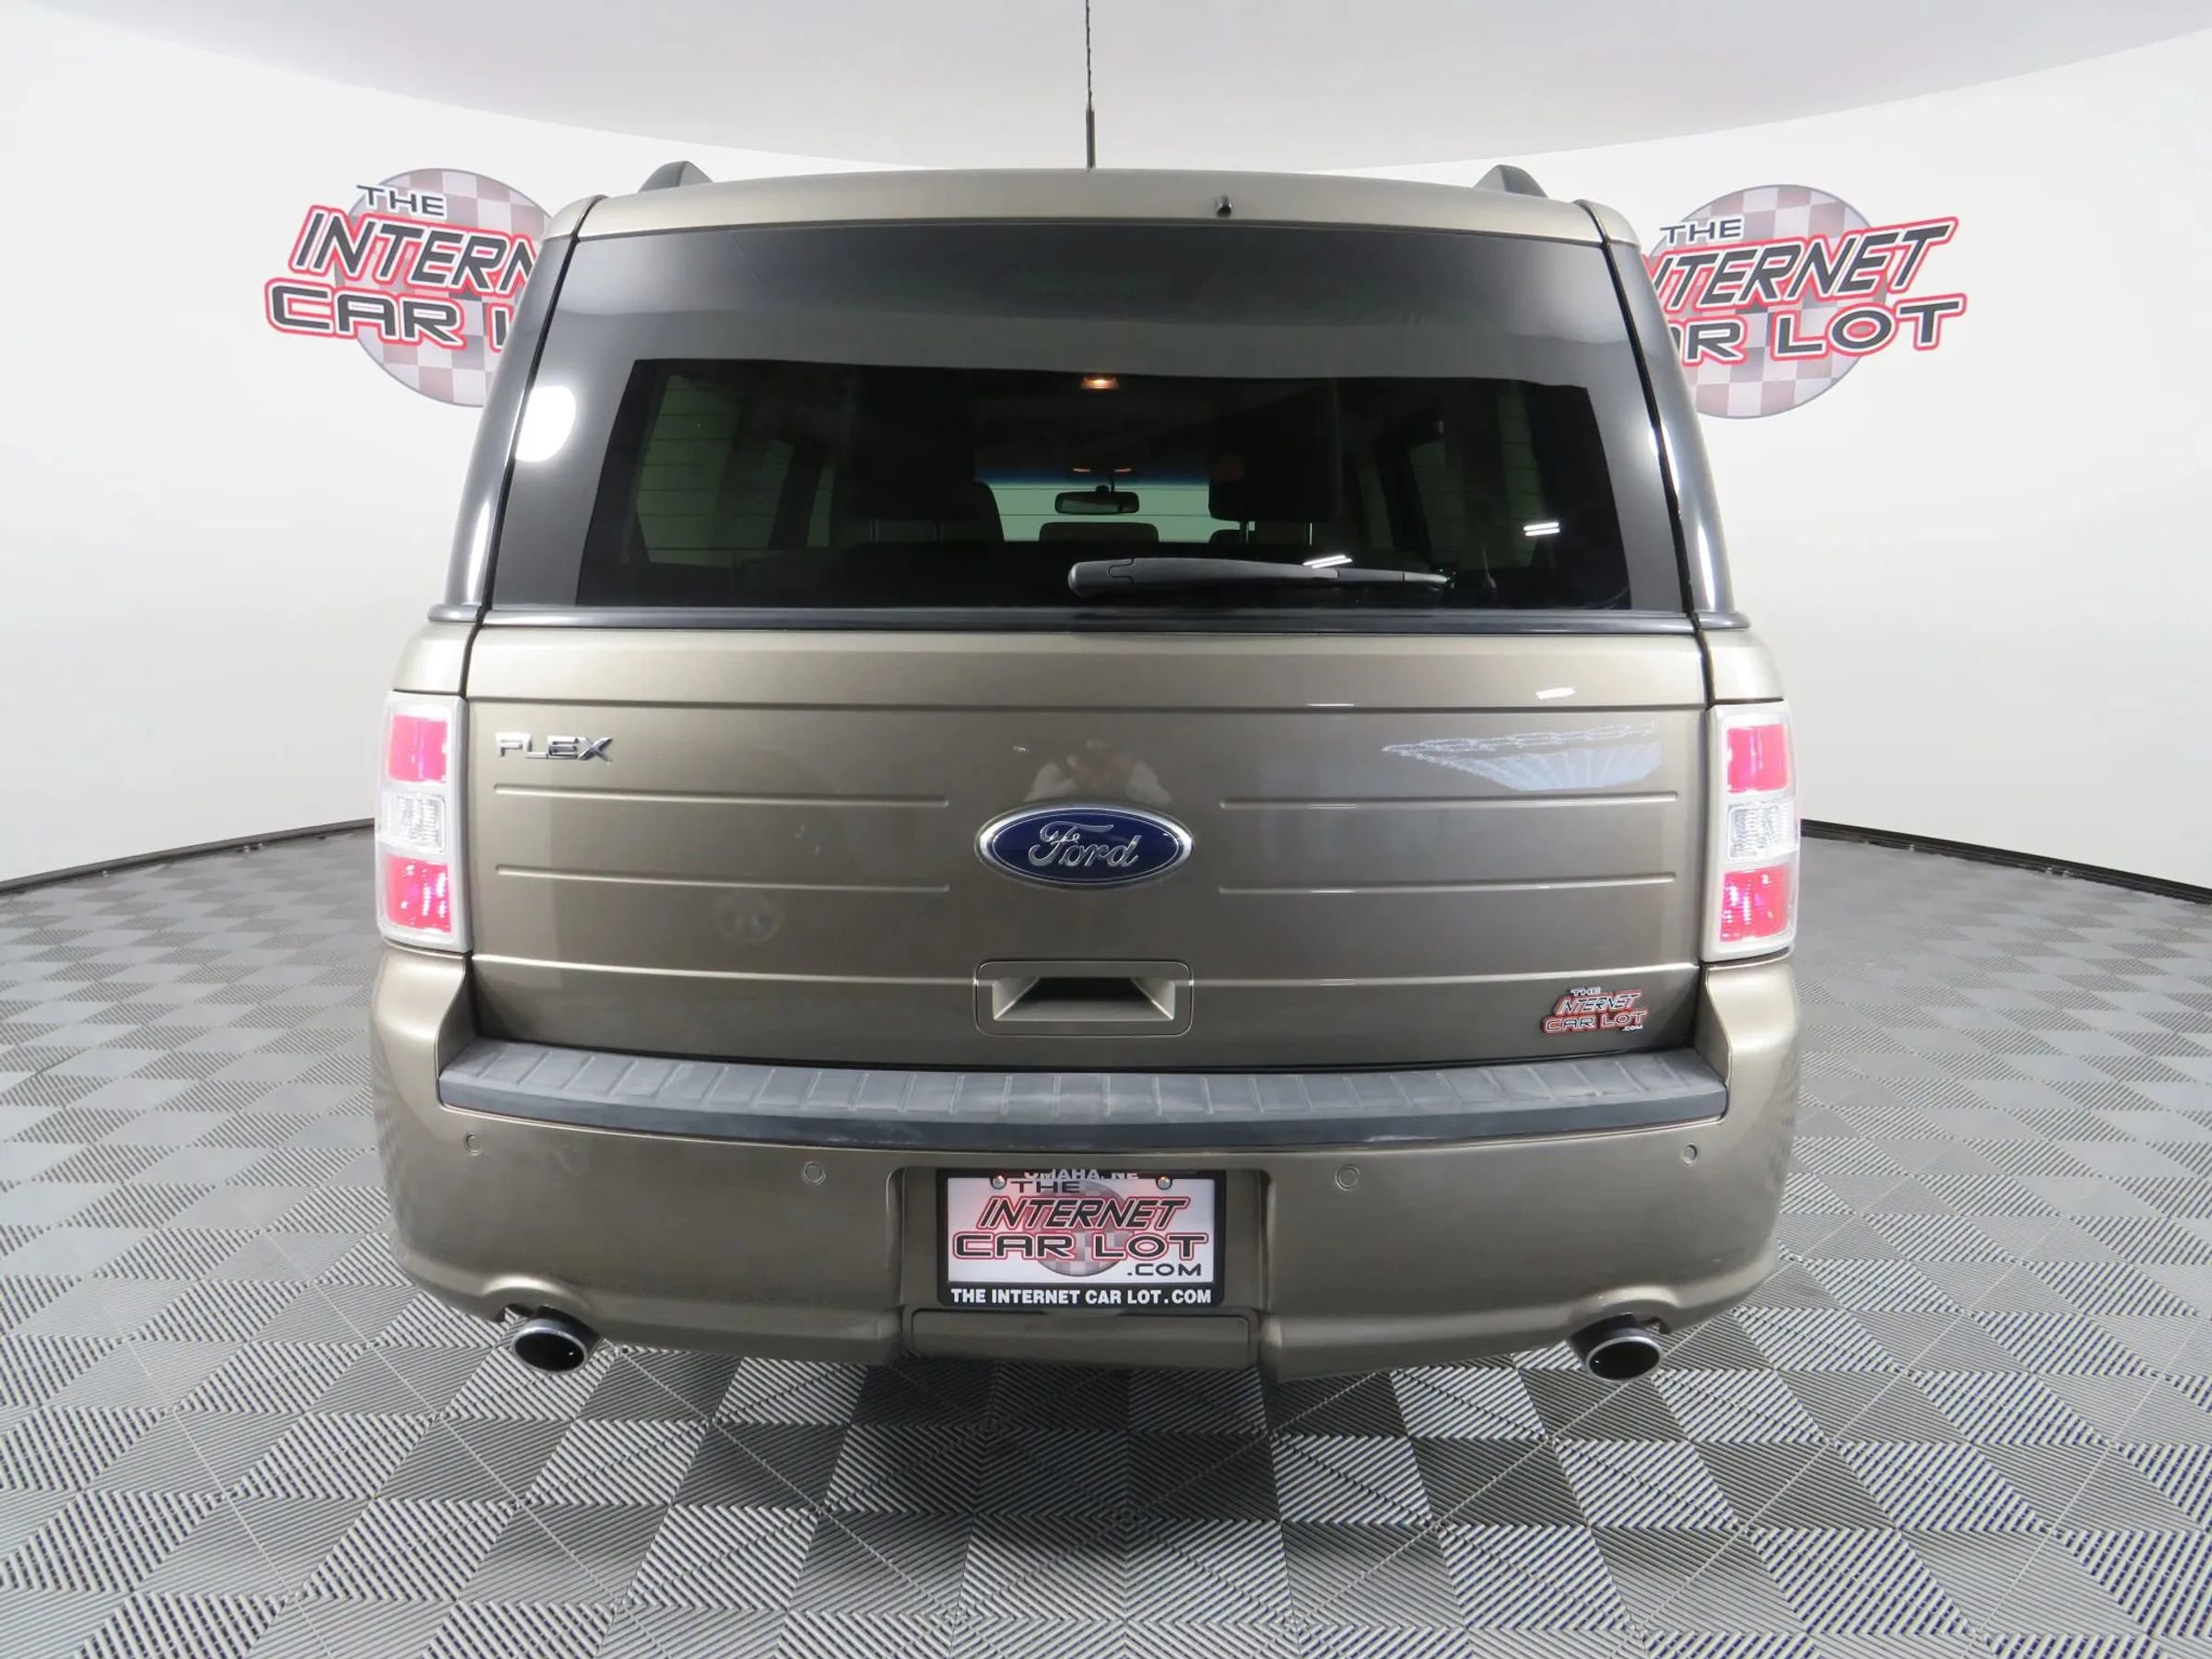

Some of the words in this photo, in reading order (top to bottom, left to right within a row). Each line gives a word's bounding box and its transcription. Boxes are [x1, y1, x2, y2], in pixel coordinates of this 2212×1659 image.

[356, 183, 446, 217] THE
[1659, 218, 1743, 244] THE
[269, 283, 465, 345] CAR
[1775, 300, 1961, 356] LOT
[496, 732, 613, 763] FLEX
[1028, 820, 1142, 867] Ford
[1555, 992, 1641, 1015] INTERNET
[1570, 986, 1601, 996] THE
[1545, 1015, 1595, 1032] CAR
[1600, 1010, 1648, 1028] LOT
[1011, 1181, 1080, 1194] THE
[978, 1197, 1189, 1230] INTERNET
[955, 1233, 1073, 1258] CAR
[1093, 1233, 1206, 1259] LOT
[1127, 1263, 1202, 1277] .COM
[950, 1288, 986, 1303] THE
[991, 1288, 1080, 1304] INTERNET
[1085, 1289, 1122, 1304] CAR
